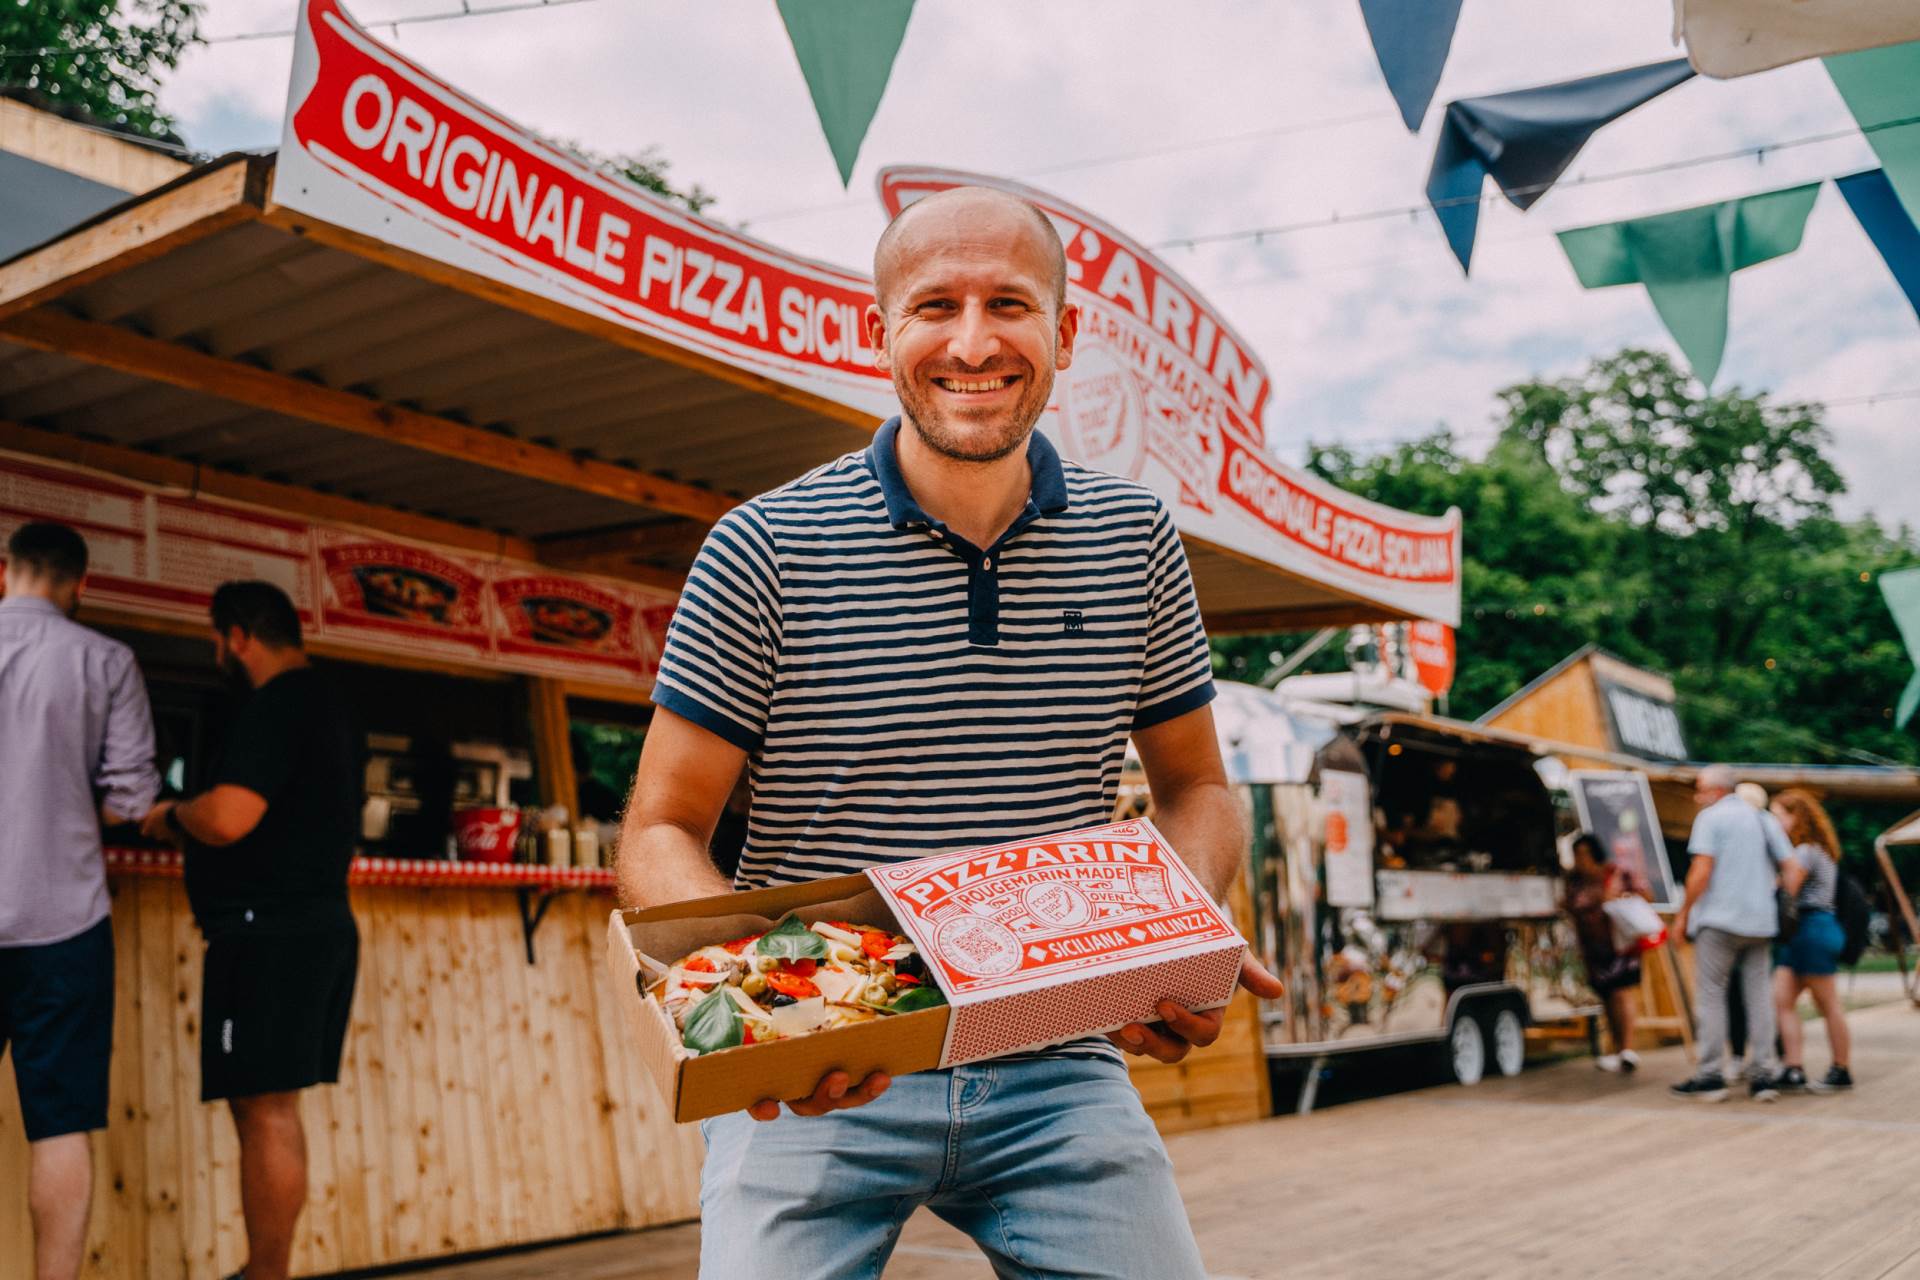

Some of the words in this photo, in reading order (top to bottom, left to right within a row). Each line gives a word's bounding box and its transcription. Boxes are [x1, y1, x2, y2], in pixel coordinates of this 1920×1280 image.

[342, 74, 631, 284] ORIGINALE
[639, 235, 769, 342] PIZZA
[904, 842, 1149, 906] PIZZ'ARIN
[958, 867, 1072, 906] ROUGEMARIN
[1076, 867, 1125, 880] MADE
[994, 905, 1024, 924] WOOD
[1090, 891, 1125, 903] OVEN
[1048, 929, 1130, 960] SICILIANA
[1151, 909, 1216, 940] MLINZZA
